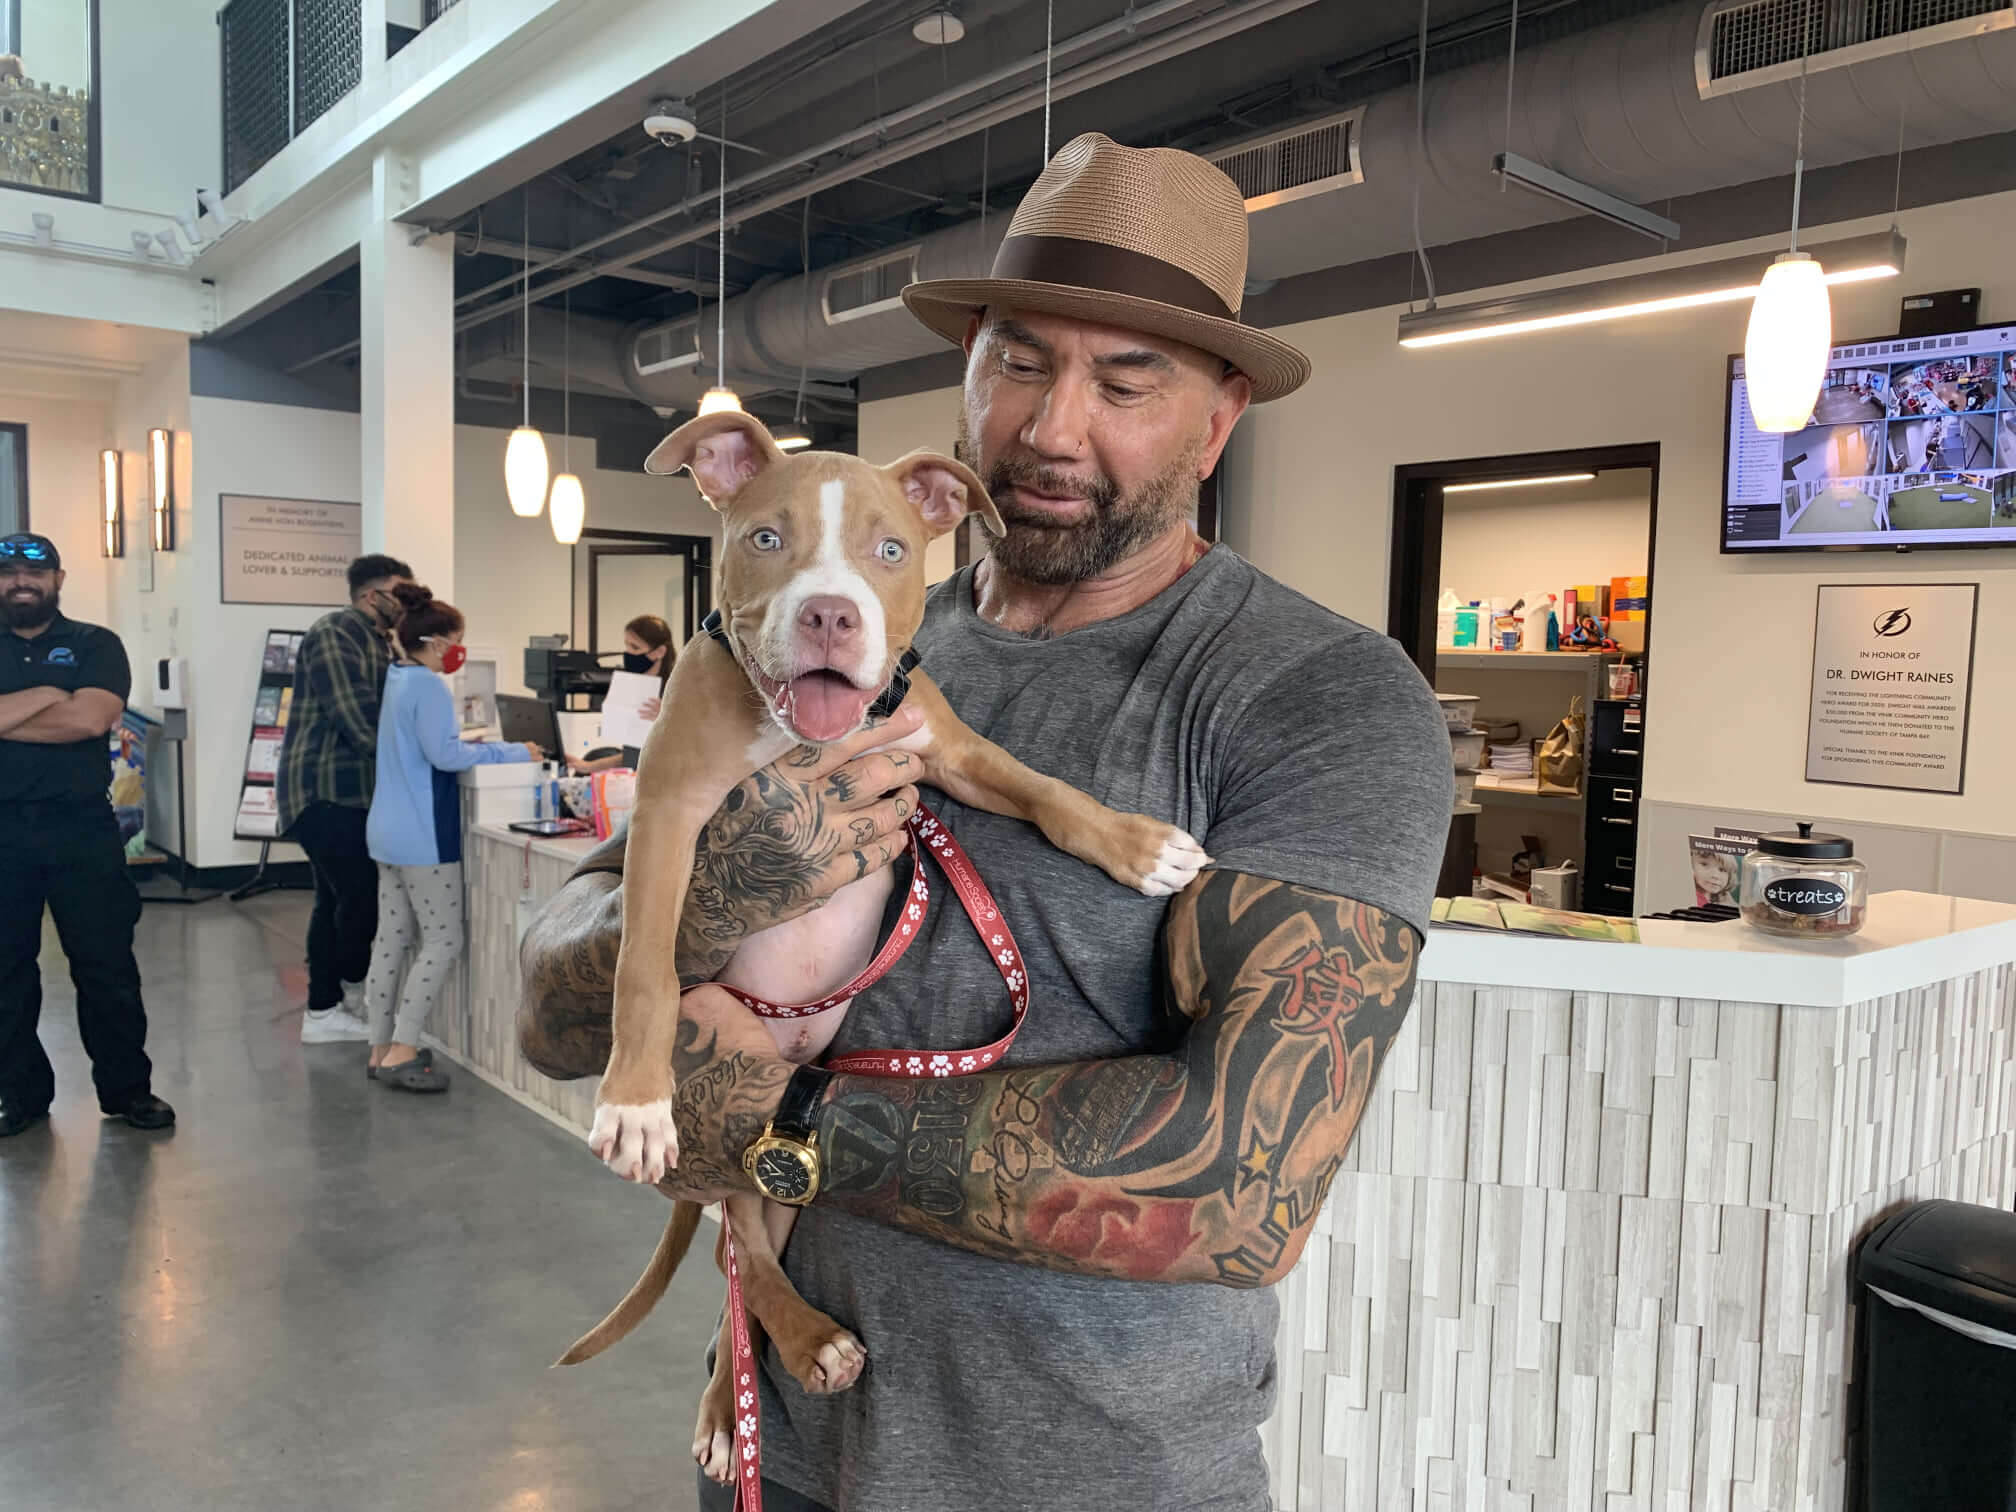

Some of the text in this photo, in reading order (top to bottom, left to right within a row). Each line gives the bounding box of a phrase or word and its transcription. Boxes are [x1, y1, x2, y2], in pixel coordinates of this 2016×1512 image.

[243, 550, 348, 565] DEDICATED ANIMAL
[242, 564, 277, 576] LOVER
[1860, 651, 1921, 660] IN HONOR OF
[1826, 669, 1954, 684] DR. DWIGHT RAINES
[1695, 841, 1714, 850] More
[1715, 844, 1737, 854] Ways
[1777, 886, 1834, 905] treats
